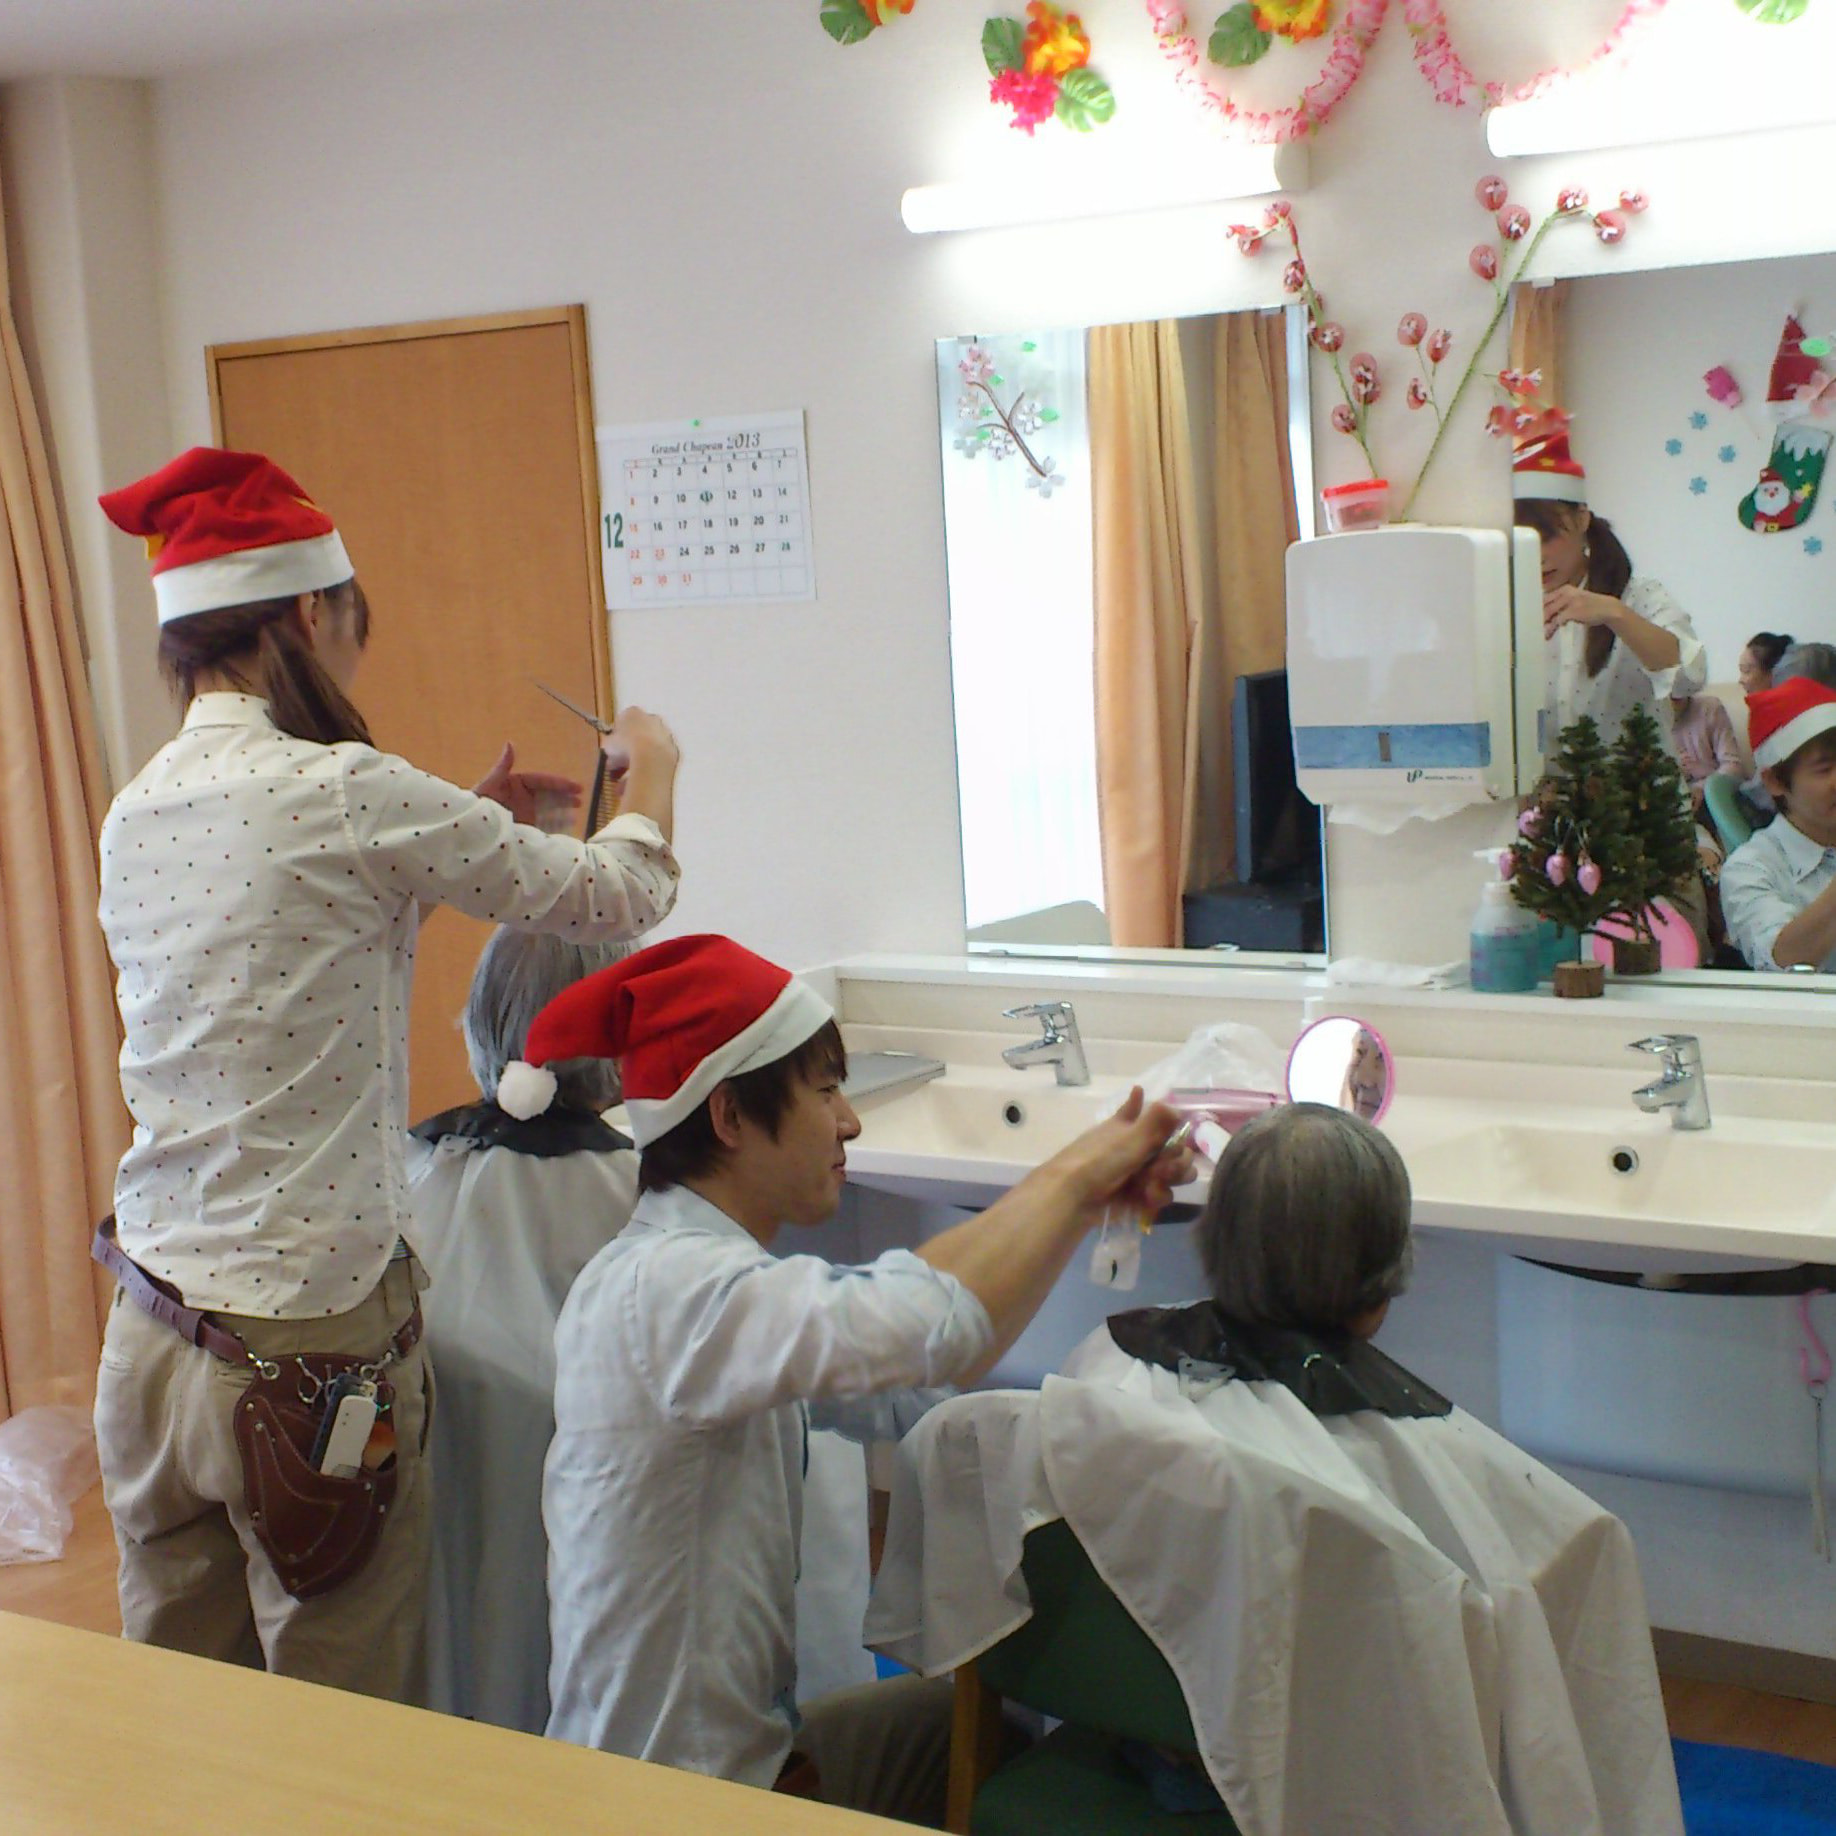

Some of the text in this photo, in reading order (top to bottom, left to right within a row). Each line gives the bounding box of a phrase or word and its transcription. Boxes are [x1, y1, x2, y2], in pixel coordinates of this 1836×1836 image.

[651, 442, 679, 454] Grand
[726, 433, 760, 449] 2013
[677, 494, 686, 502] 10
[727, 491, 736, 499] 12
[753, 489, 762, 498] 13
[778, 488, 786, 496] 14
[605, 513, 623, 548] 12
[653, 522, 662, 531] 16
[678, 521, 687, 529] 17
[704, 520, 712, 528] 18
[729, 518, 738, 526] 19
[754, 516, 764, 525] 20
[780, 515, 788, 523] 21
[630, 550, 639, 559] 22
[680, 548, 689, 556] 24
[704, 546, 714, 555] 25
[730, 545, 739, 553] 26
[755, 544, 765, 552] 27
[782, 543, 790, 551] 28
[633, 577, 642, 585] 29
